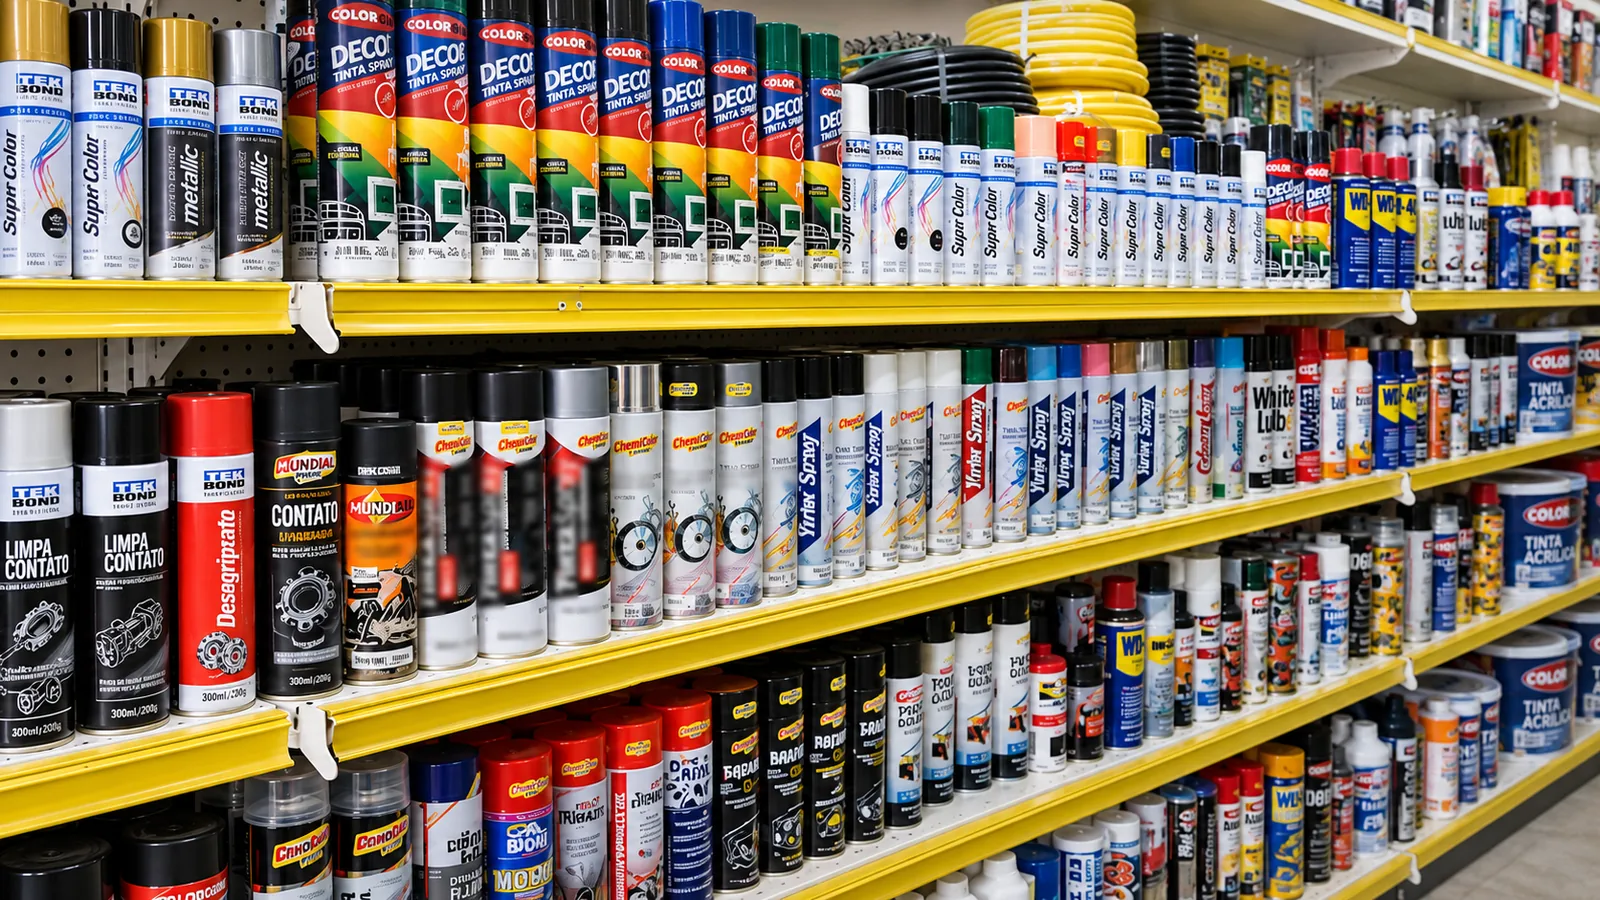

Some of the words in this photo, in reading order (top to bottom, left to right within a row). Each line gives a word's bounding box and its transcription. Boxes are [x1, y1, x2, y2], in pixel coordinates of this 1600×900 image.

[332, 66, 366, 83] TINTA
[368, 57, 394, 73] SPRAY
[407, 73, 438, 90] TINTA
[441, 65, 466, 80] SPRAY
[18, 73, 63, 86] TEK
[96, 80, 137, 93] TEK
[604, 68, 651, 99] DECO
[16, 84, 63, 96] BOND
[94, 91, 137, 103] BOND
[171, 88, 209, 101] TEK
[482, 82, 511, 98] TINTA
[546, 90, 576, 104] TINTA
[170, 98, 209, 109] BOND
[241, 97, 277, 108] TEK
[606, 97, 634, 110] TINTA
[240, 106, 278, 117] BOND
[663, 105, 689, 118] TINTA
[714, 110, 739, 124] TINTA
[3, 129, 17, 183] Color
[83, 134, 99, 184] Color
[184, 143, 199, 226] metallic
[253, 151, 268, 230] metallic
[952, 183, 964, 218] Color
[985, 187, 997, 221] Color
[1034, 191, 1046, 222] Color
[1068, 194, 1079, 224] Color
[1098, 198, 1109, 228] Color
[1127, 200, 1136, 229] Color
[1154, 202, 1164, 231] Color
[1178, 204, 1187, 232] Color
[1204, 206, 1213, 234] Color
[1228, 208, 1236, 235] Color
[1532, 354, 1571, 369] COLOR
[1577, 349, 1600, 362] COL
[1529, 381, 1564, 396] TINTA
[1528, 394, 1574, 410] ACRILIC
[276, 455, 334, 474] MUNDIAL
[206, 468, 244, 480] TEK
[14, 484, 59, 497] TEK
[114, 479, 156, 492] TEK
[204, 479, 245, 490] BOND
[12, 496, 59, 508] BOND
[113, 491, 156, 502] BOND
[272, 500, 338, 527] CONTATO
[1527, 506, 1569, 522] COLOR
[6, 538, 52, 559] LIMPA
[104, 532, 148, 553] LIMPA
[1524, 534, 1562, 549] TINTA
[5, 554, 69, 580] CONTATO
[104, 547, 164, 573] CONTATO
[1122, 635, 1144, 656] WD-
[1526, 668, 1568, 686] COLOR
[1523, 698, 1560, 713] TINTA
